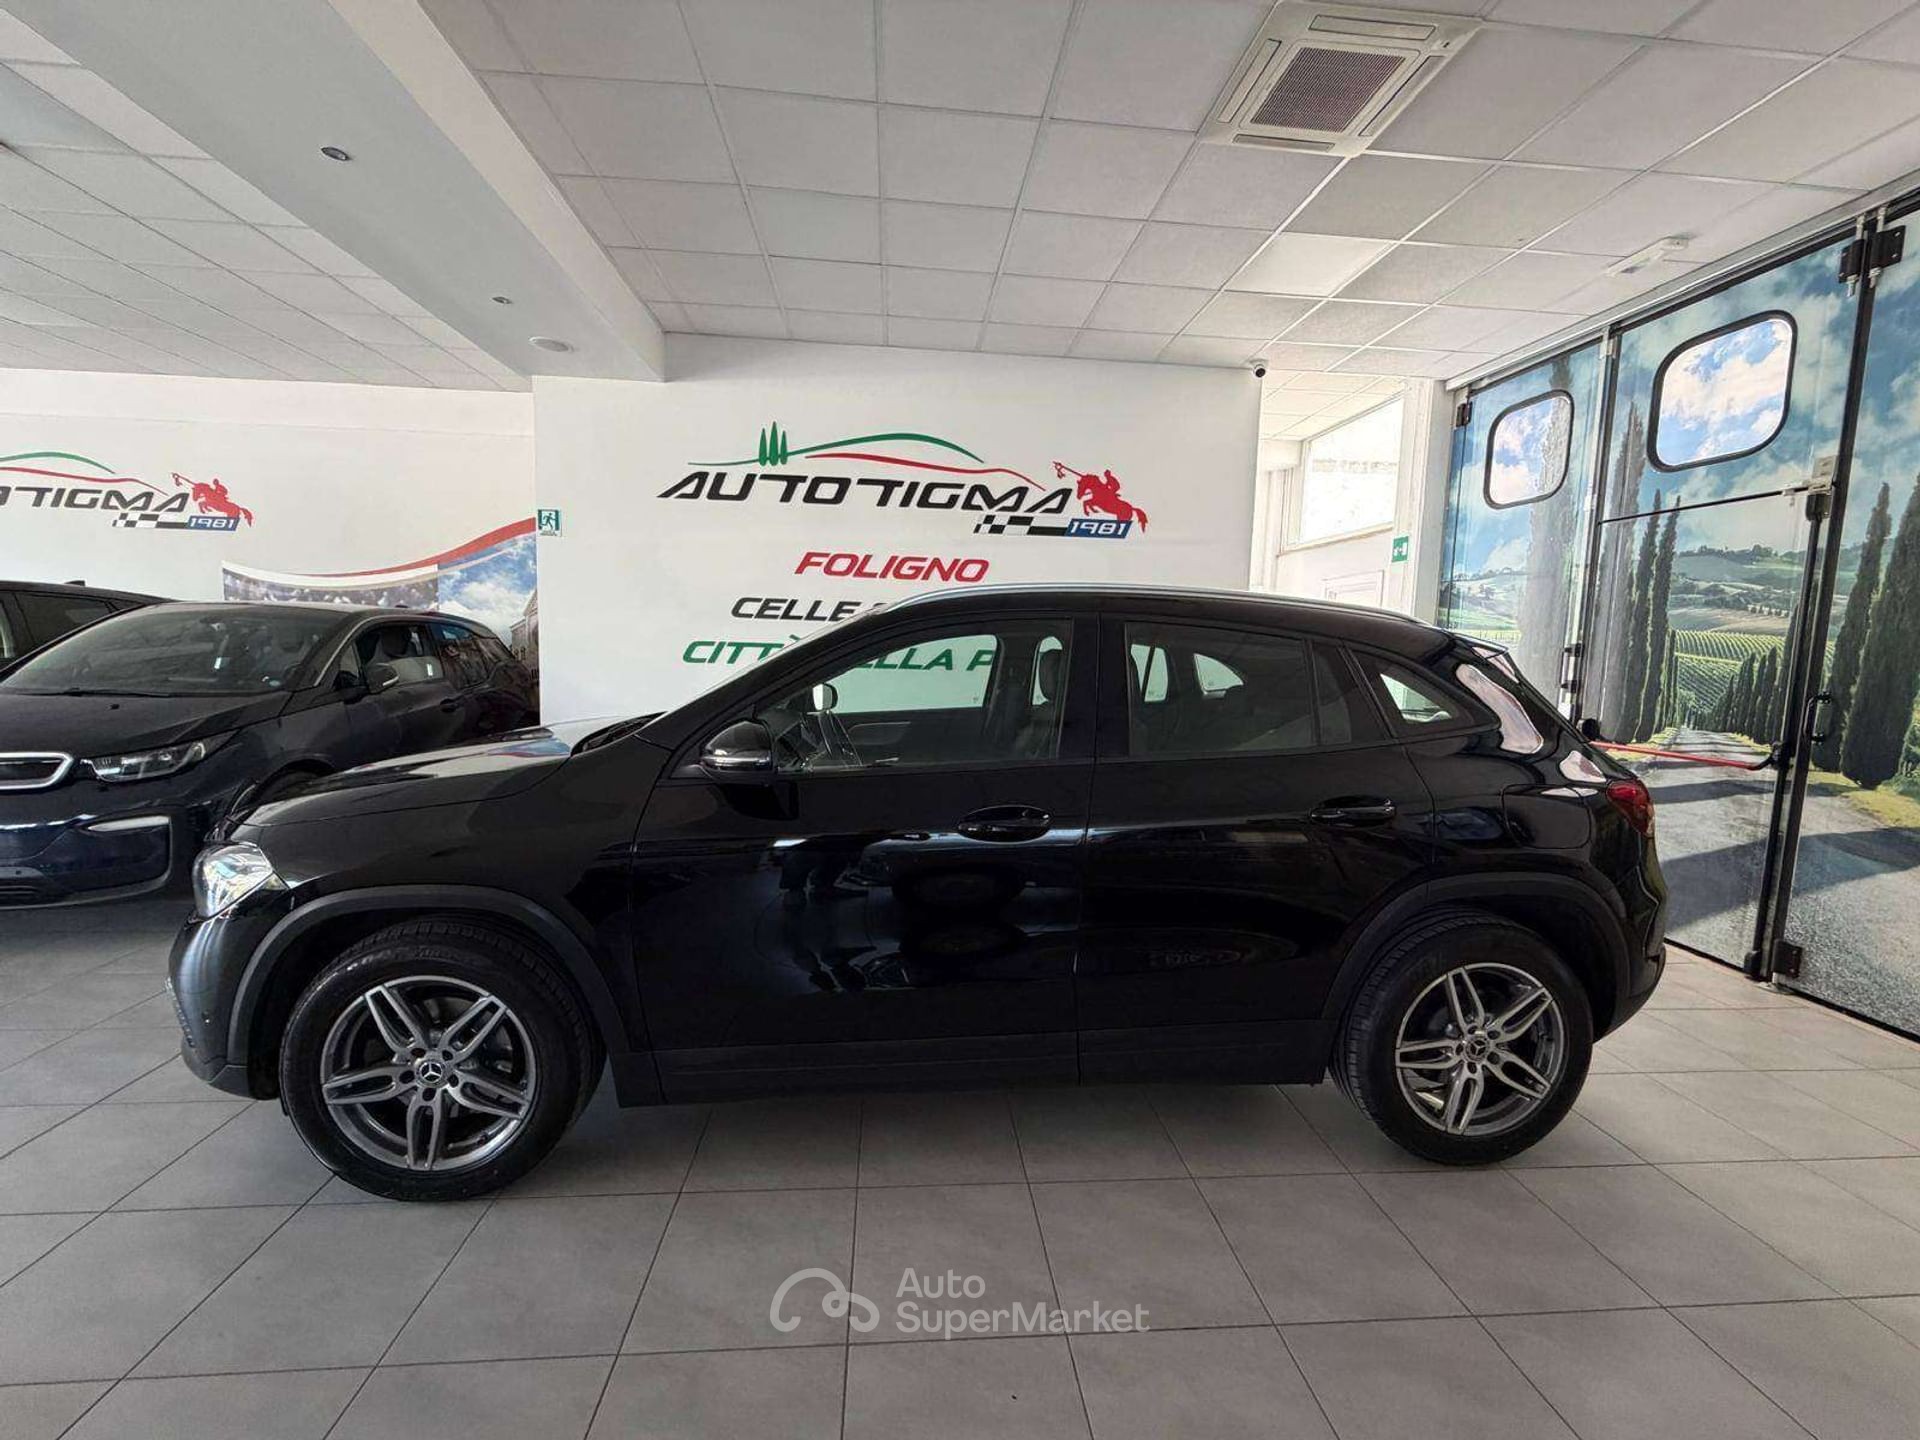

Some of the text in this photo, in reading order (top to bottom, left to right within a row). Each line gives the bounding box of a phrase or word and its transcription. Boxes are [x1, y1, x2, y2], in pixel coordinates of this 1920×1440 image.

[0, 486, 190, 512] TIGMA
[656, 471, 1072, 514] AUTOTIGMA
[190, 517, 235, 529] 1981
[1070, 520, 1127, 537] 1981
[795, 552, 989, 583] FOLIGNO
[731, 597, 861, 622] CELLE
[682, 634, 801, 665] CITT
